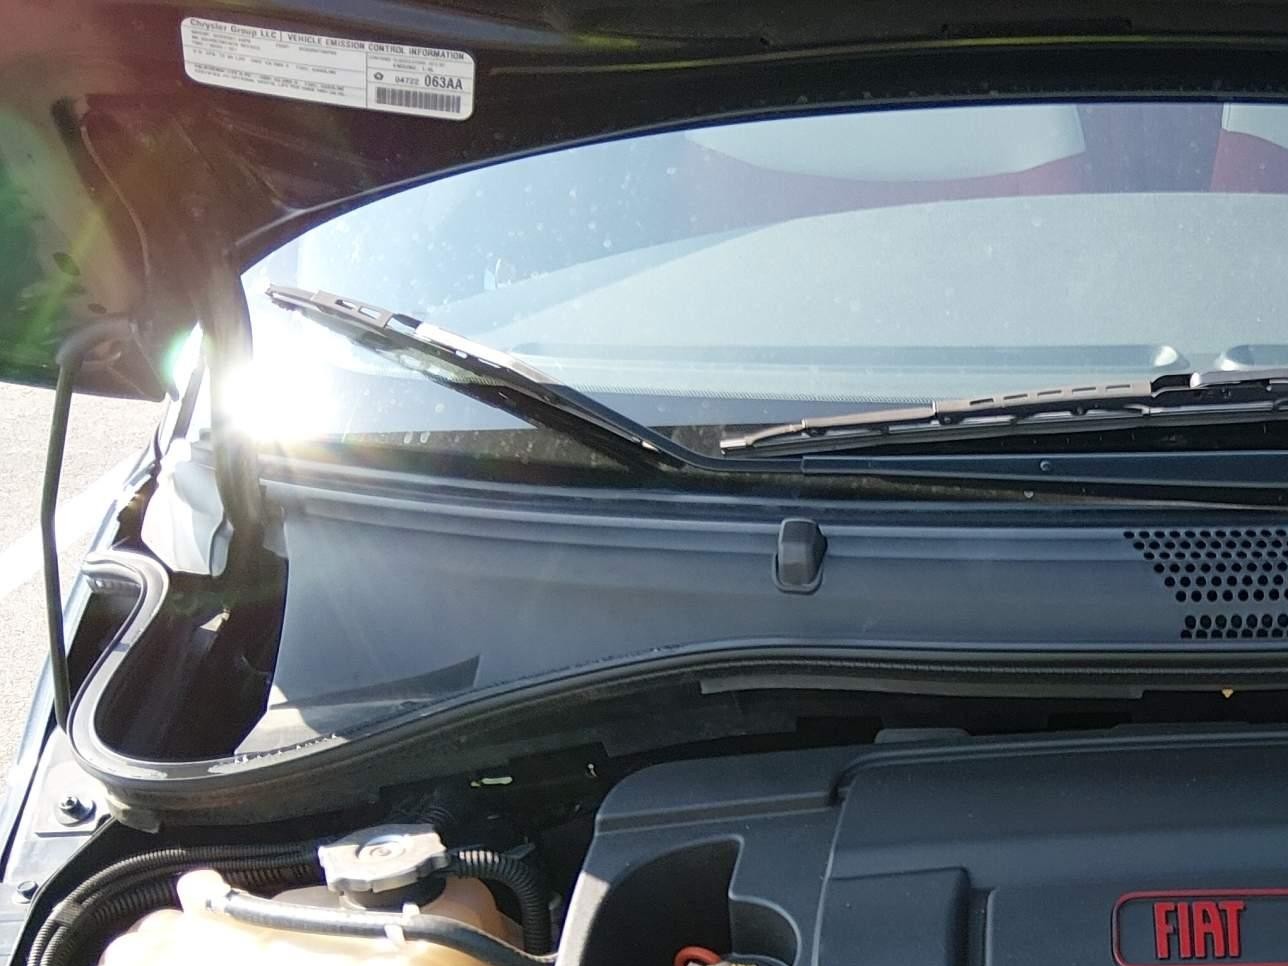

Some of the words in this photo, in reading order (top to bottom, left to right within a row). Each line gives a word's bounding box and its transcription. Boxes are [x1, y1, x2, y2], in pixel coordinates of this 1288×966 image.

[190, 19, 227, 31] Chrysler
[230, 26, 258, 38] Group
[260, 30, 277, 39] LLC
[288, 33, 322, 44] VEHICLE
[325, 38, 365, 50] EMISSION
[368, 43, 404, 55] CONTROL
[409, 47, 465, 60] INFORMATION
[424, 74, 463, 91] 063AA
[1152, 901, 1246, 960] FIAT
